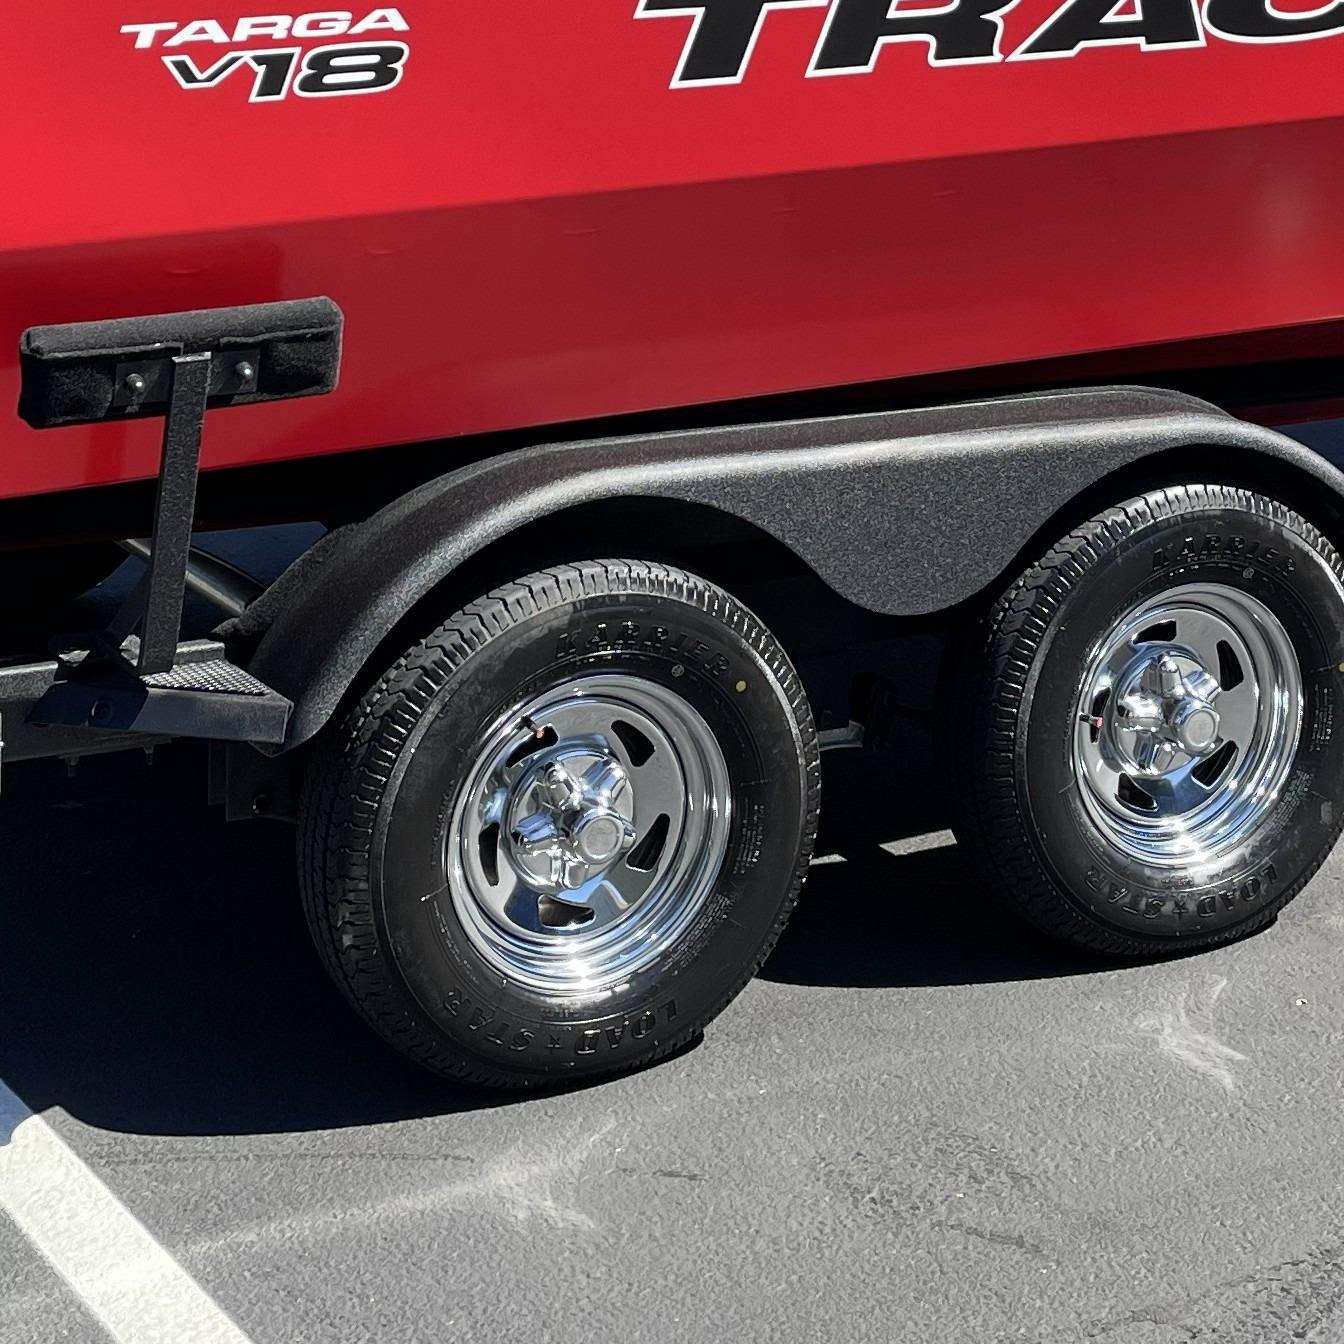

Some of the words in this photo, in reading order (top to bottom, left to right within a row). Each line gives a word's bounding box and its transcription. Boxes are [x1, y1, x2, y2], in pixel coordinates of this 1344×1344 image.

[119, 7, 411, 49] TARGA
[160, 40, 411, 104] V18
[556, 620, 731, 677] KARRIER
[442, 991, 536, 1052] STAR
[575, 999, 678, 1055] LOAD
